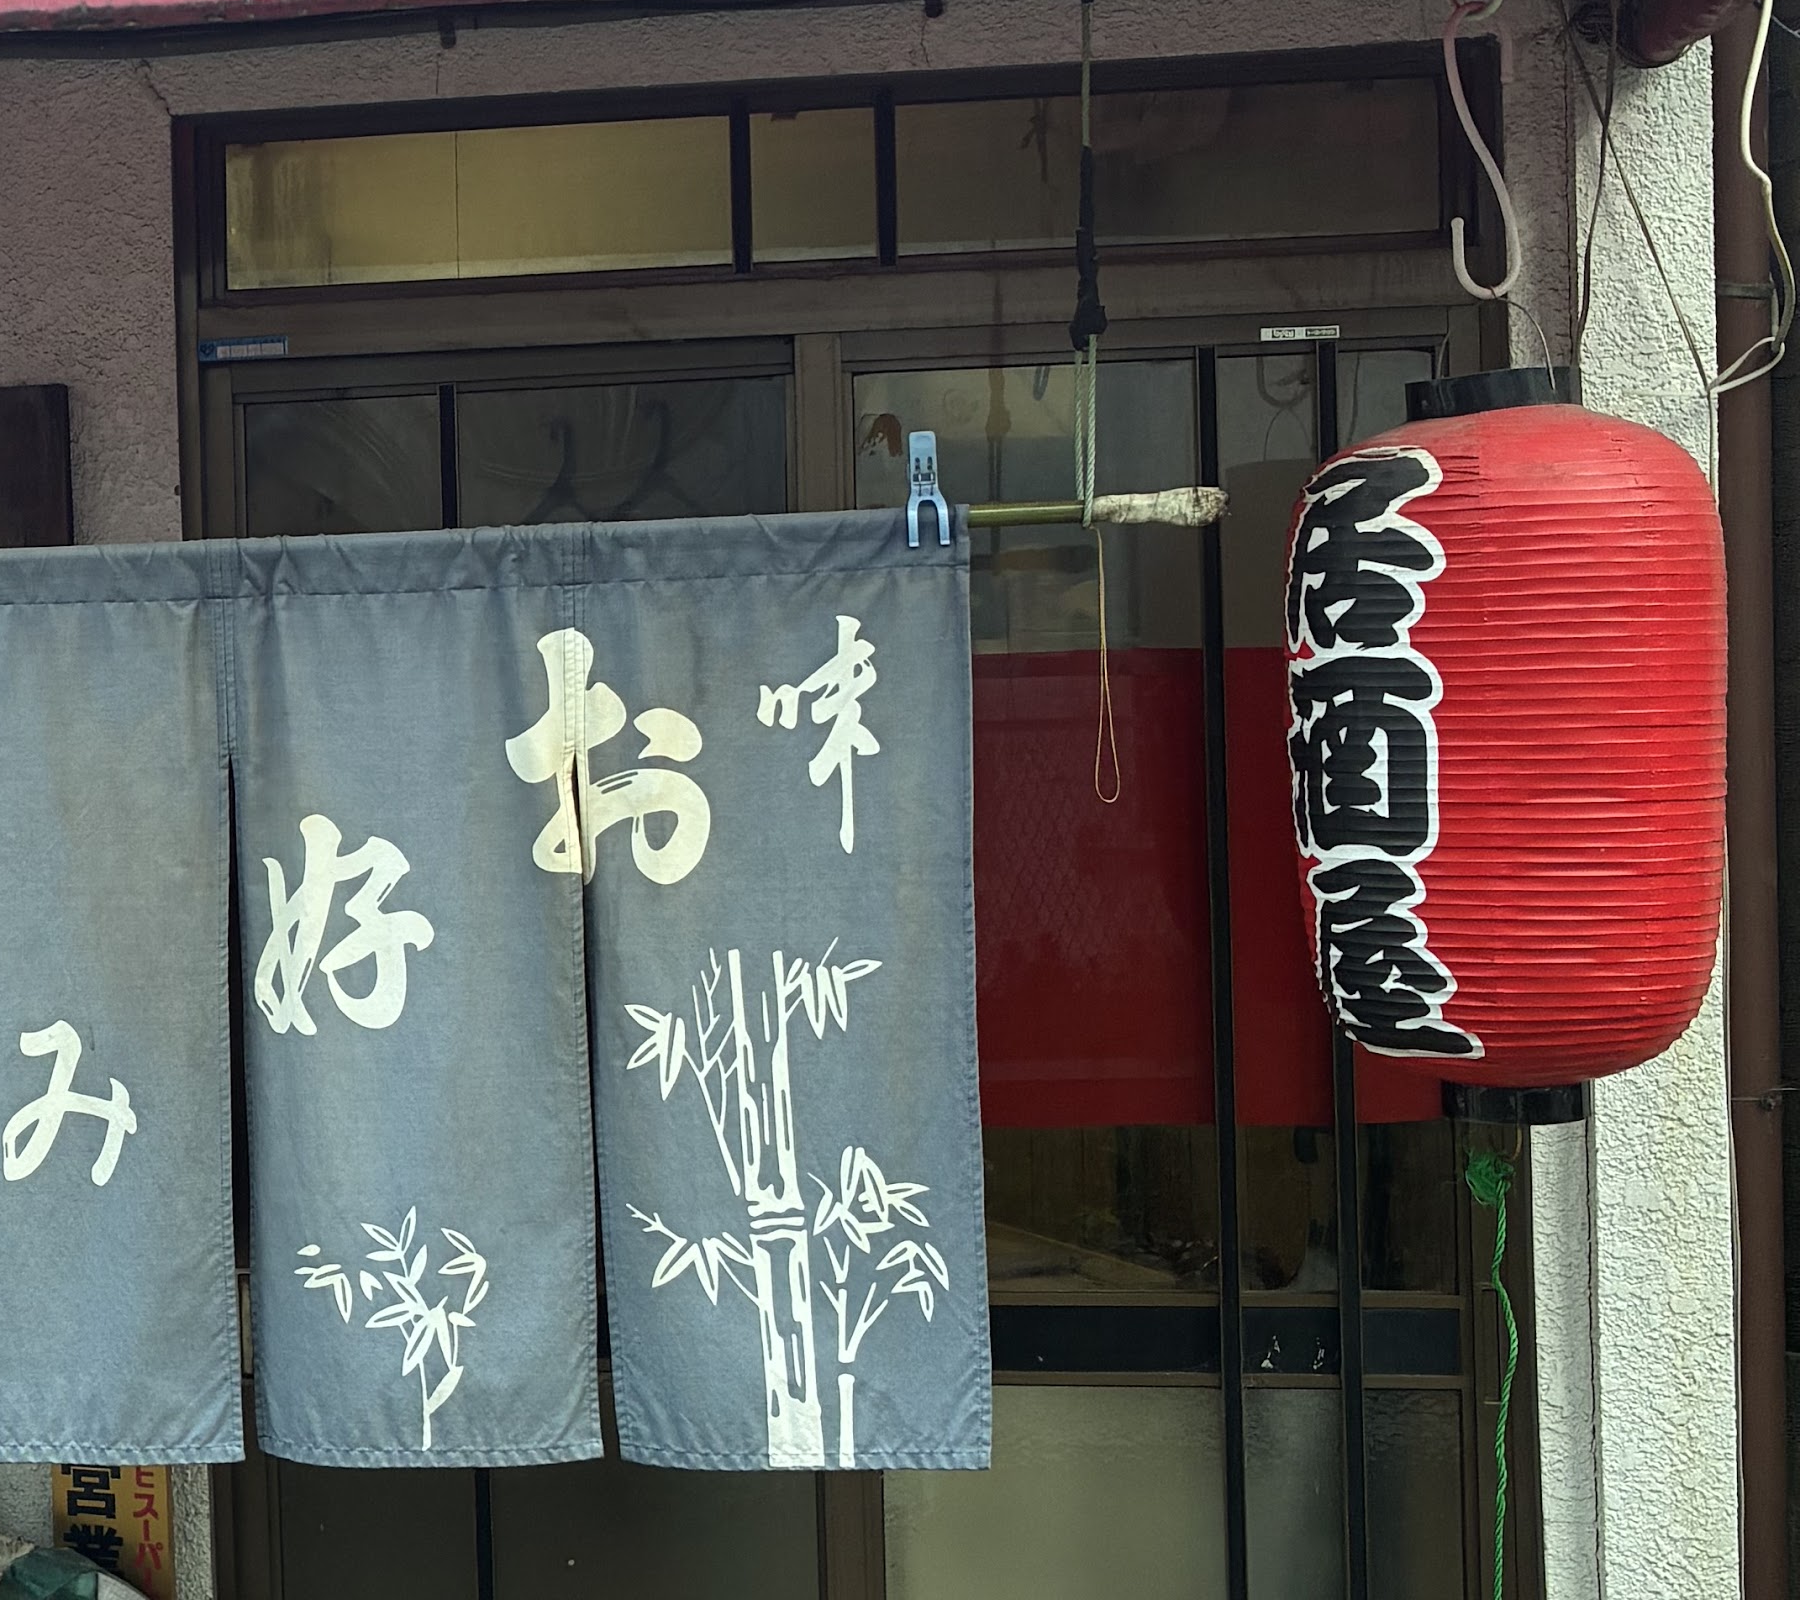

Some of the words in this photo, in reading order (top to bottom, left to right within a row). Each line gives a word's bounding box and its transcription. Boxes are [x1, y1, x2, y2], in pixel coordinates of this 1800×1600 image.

[757, 615, 878, 853] 味
[1286, 447, 1484, 1058] 居酒屋
